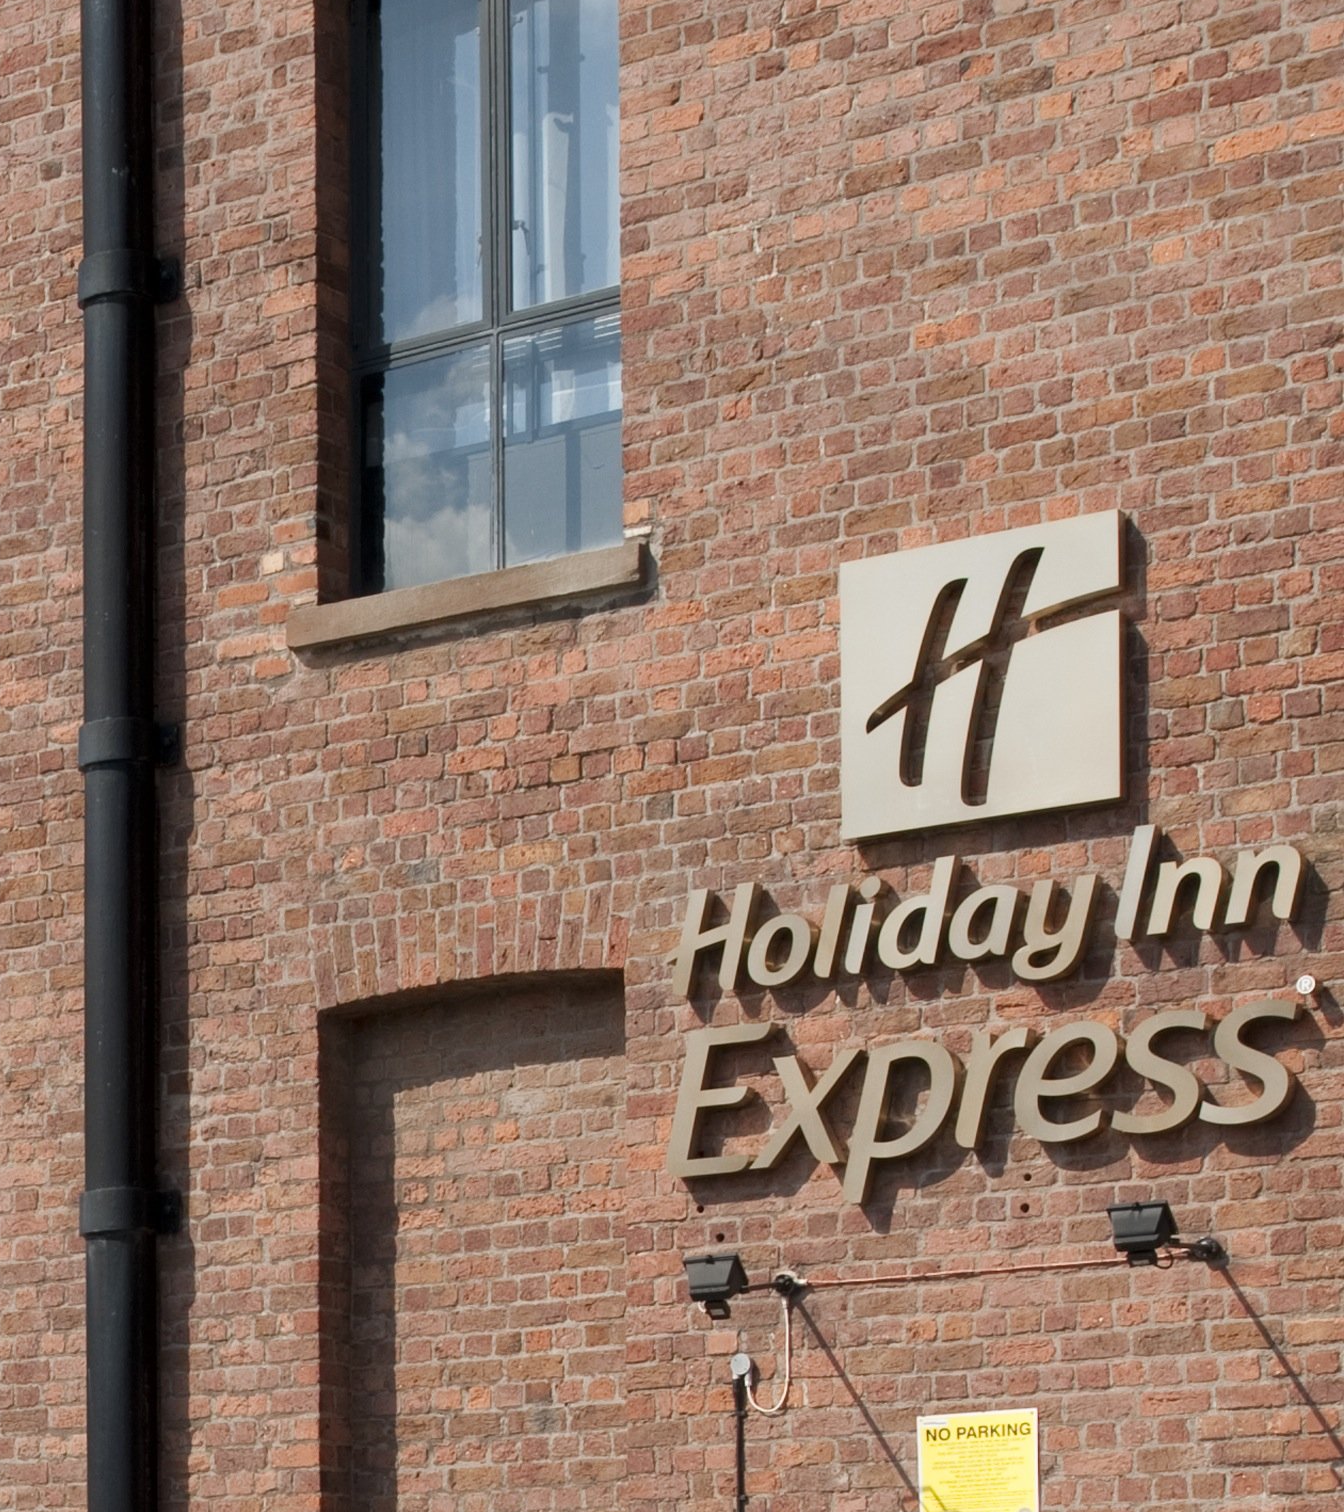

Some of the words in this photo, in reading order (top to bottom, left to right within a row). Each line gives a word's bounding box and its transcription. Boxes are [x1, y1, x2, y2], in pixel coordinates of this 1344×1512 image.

[667, 855, 1100, 998] Holiday
[1115, 825, 1308, 941] Inn
[666, 999, 1304, 1204] Express
[926, 1428, 950, 1442] NO
[956, 1422, 1032, 1440] PARKING
